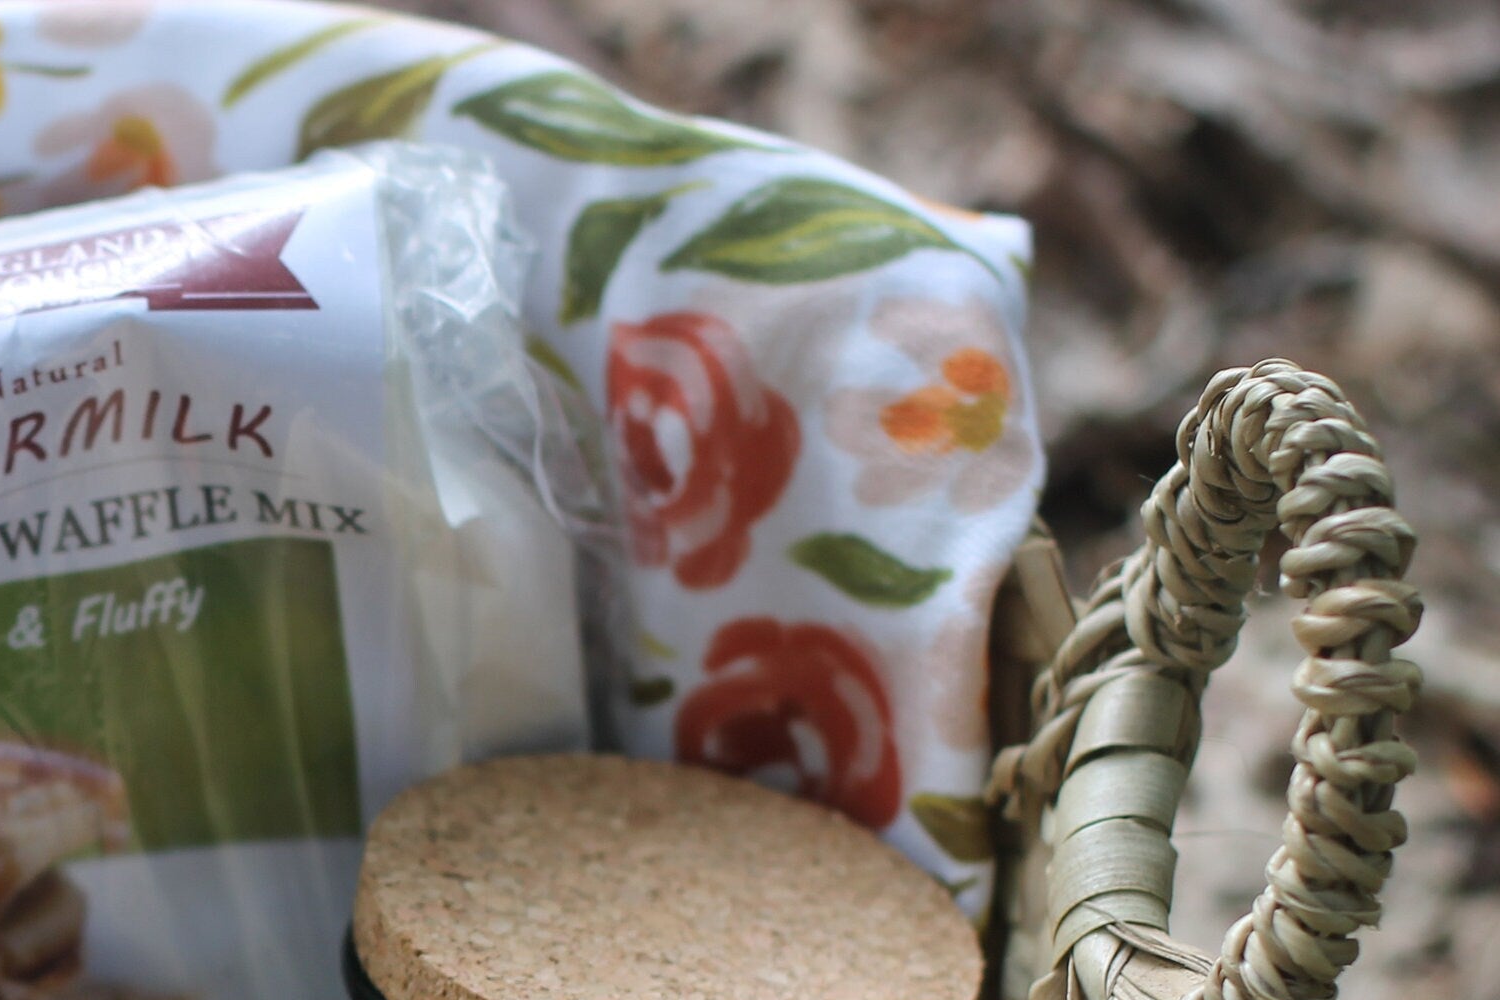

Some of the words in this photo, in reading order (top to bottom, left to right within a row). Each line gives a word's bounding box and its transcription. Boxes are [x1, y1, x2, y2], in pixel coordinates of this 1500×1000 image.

[255, 490, 368, 536] MIX
[7, 605, 45, 652] &
[73, 579, 205, 643] Fluffy
